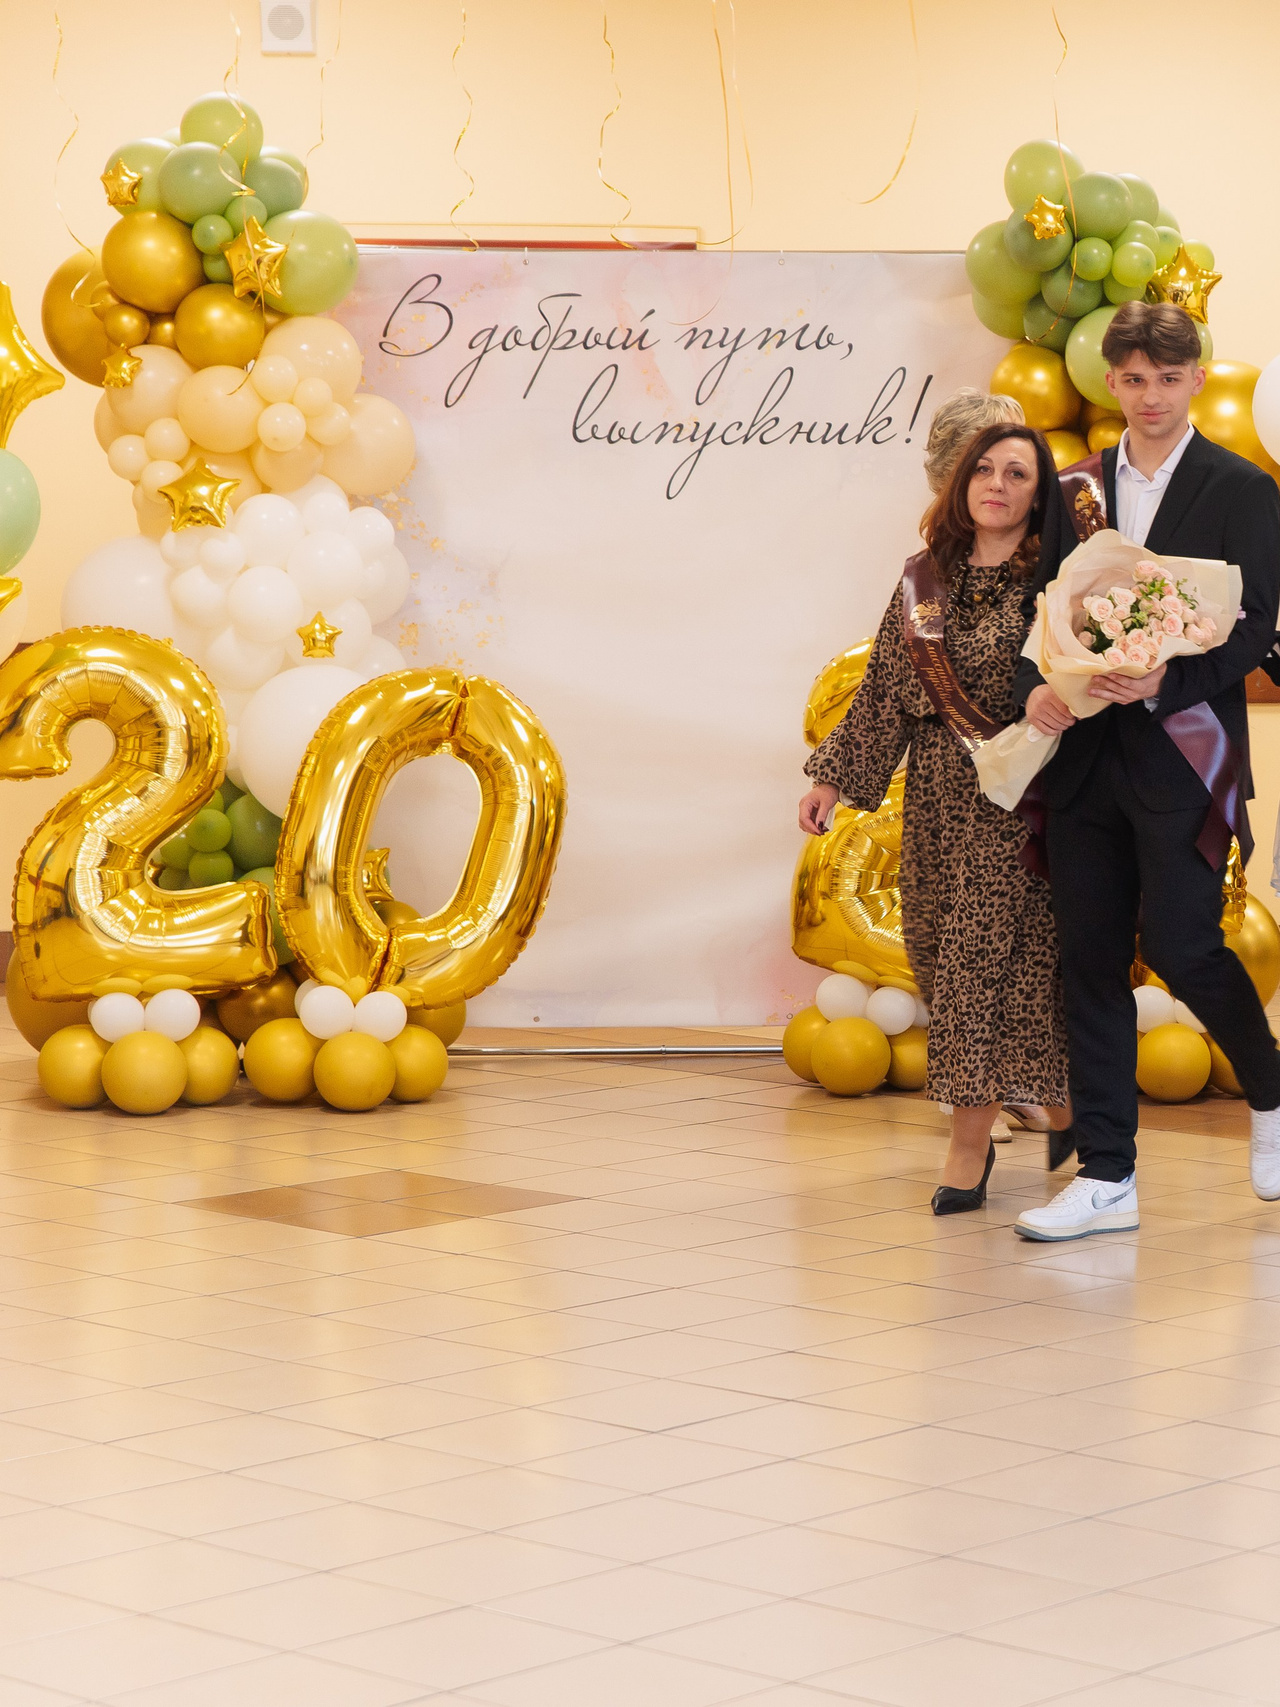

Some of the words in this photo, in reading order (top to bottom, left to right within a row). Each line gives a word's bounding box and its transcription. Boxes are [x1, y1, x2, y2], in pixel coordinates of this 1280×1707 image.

[378, 273, 454, 357] В
[444, 292, 662, 407] добрый
[672, 318, 855, 406] путь,
[570, 362, 935, 500] выпускник!
[924, 626, 954, 694] Классный
